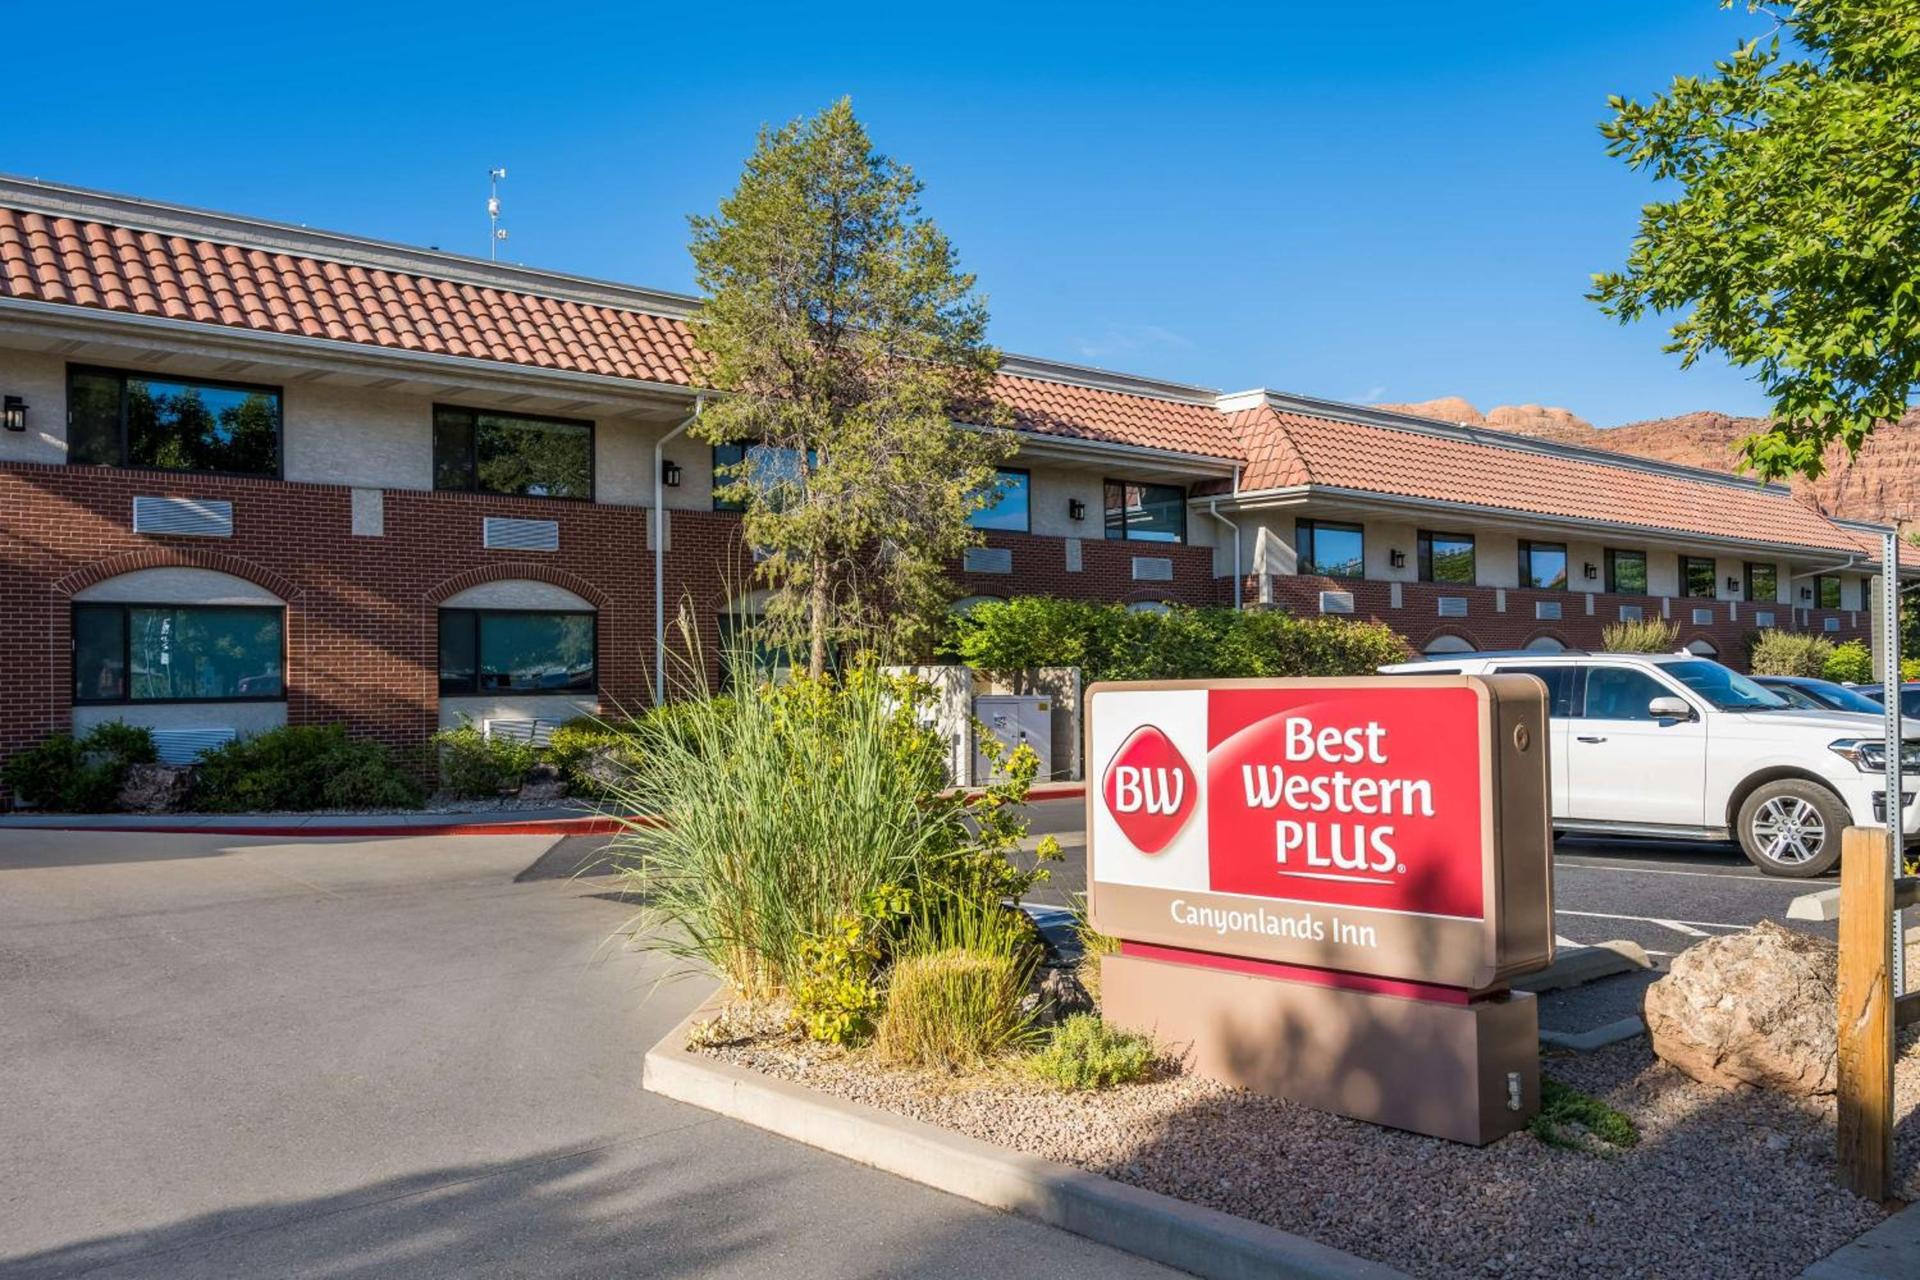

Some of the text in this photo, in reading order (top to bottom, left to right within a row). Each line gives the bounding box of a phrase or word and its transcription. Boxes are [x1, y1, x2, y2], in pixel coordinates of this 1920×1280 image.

[1285, 717, 1387, 763] Best
[1115, 765, 1184, 815] BW
[1242, 765, 1434, 816] Western
[1170, 900, 1377, 948] Canyonlands Inn
